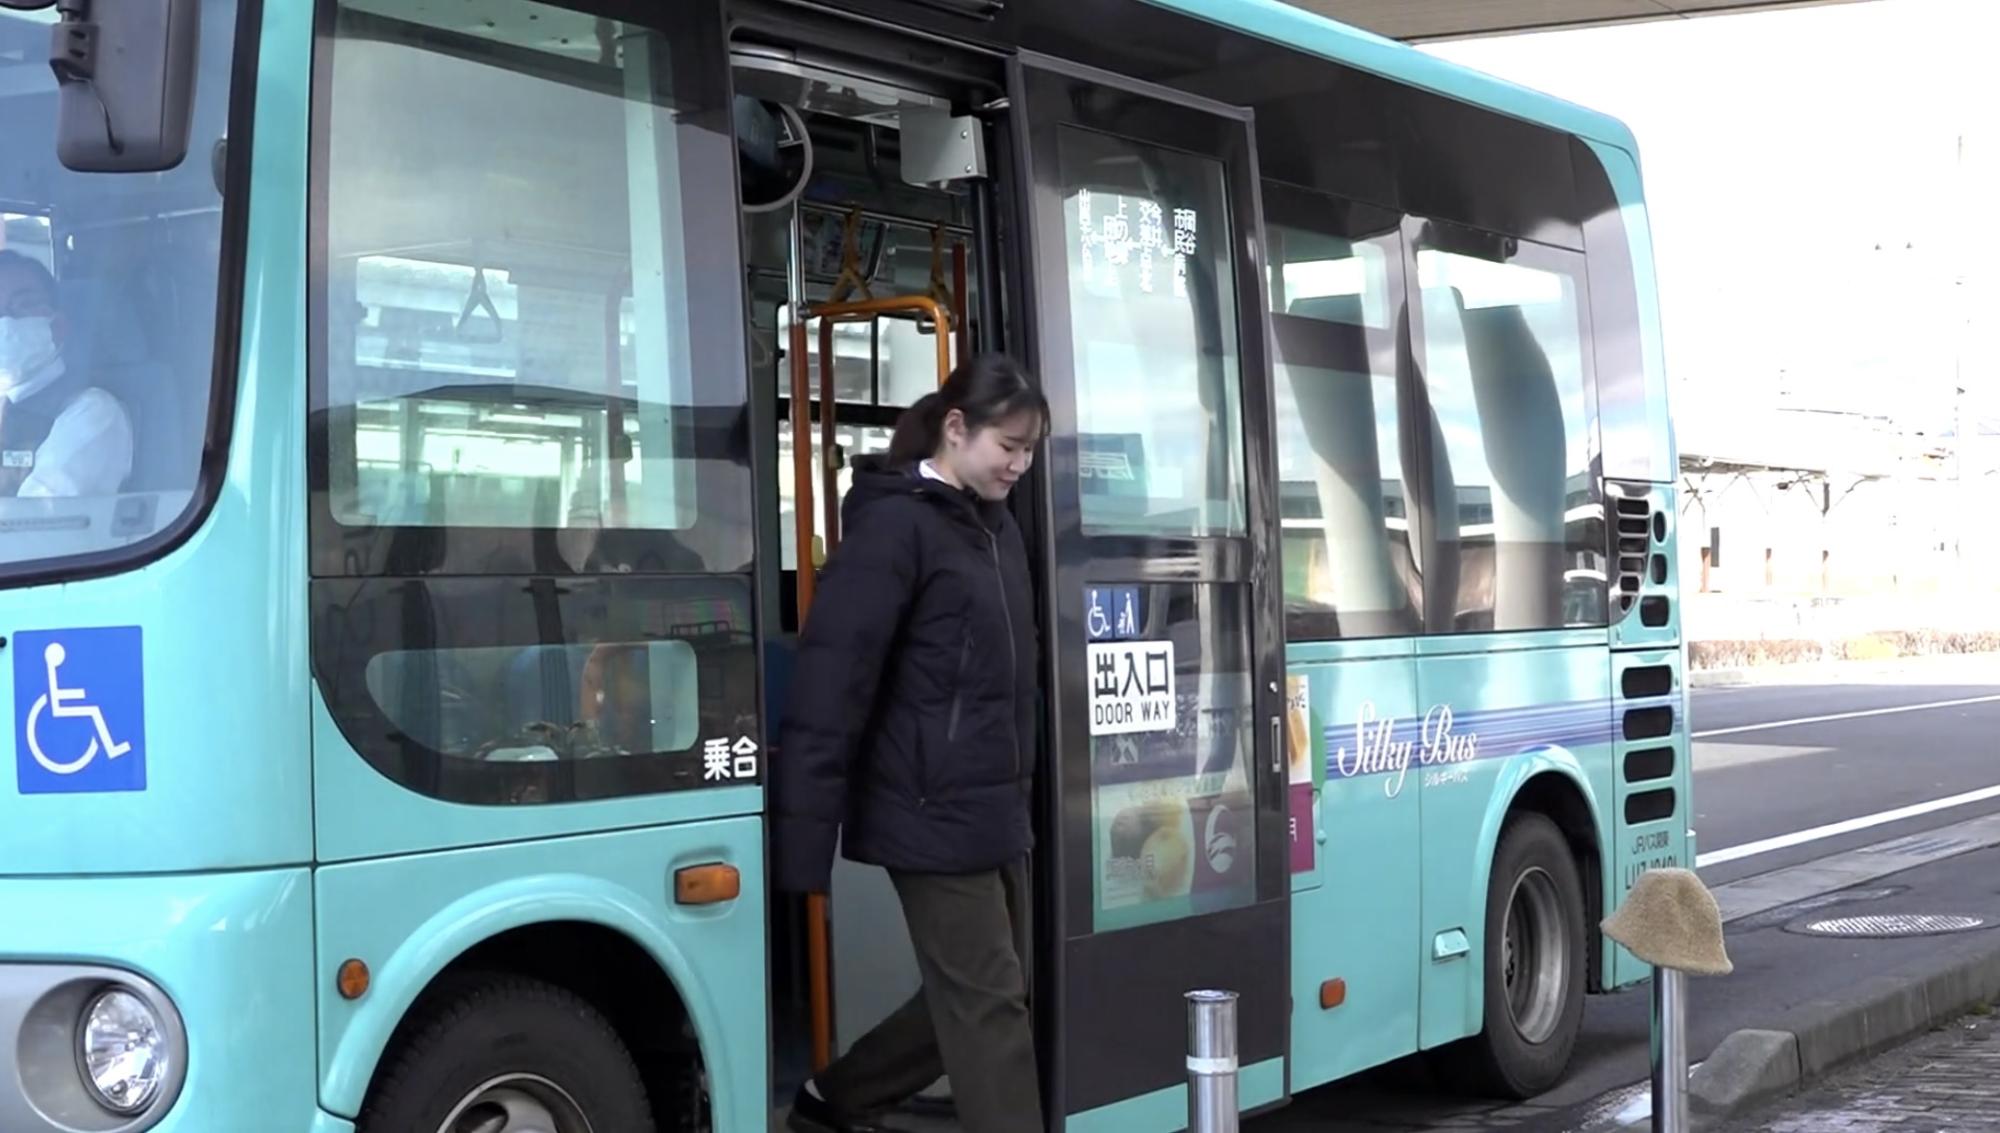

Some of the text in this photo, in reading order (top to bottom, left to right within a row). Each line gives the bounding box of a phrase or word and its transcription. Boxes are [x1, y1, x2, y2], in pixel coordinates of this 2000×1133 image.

[1094, 651, 1170, 698] 出入口
[1095, 700, 1170, 725] DOOR WAY
[703, 735, 759, 781] 乗合
[1337, 700, 1478, 799] Silky Bus
